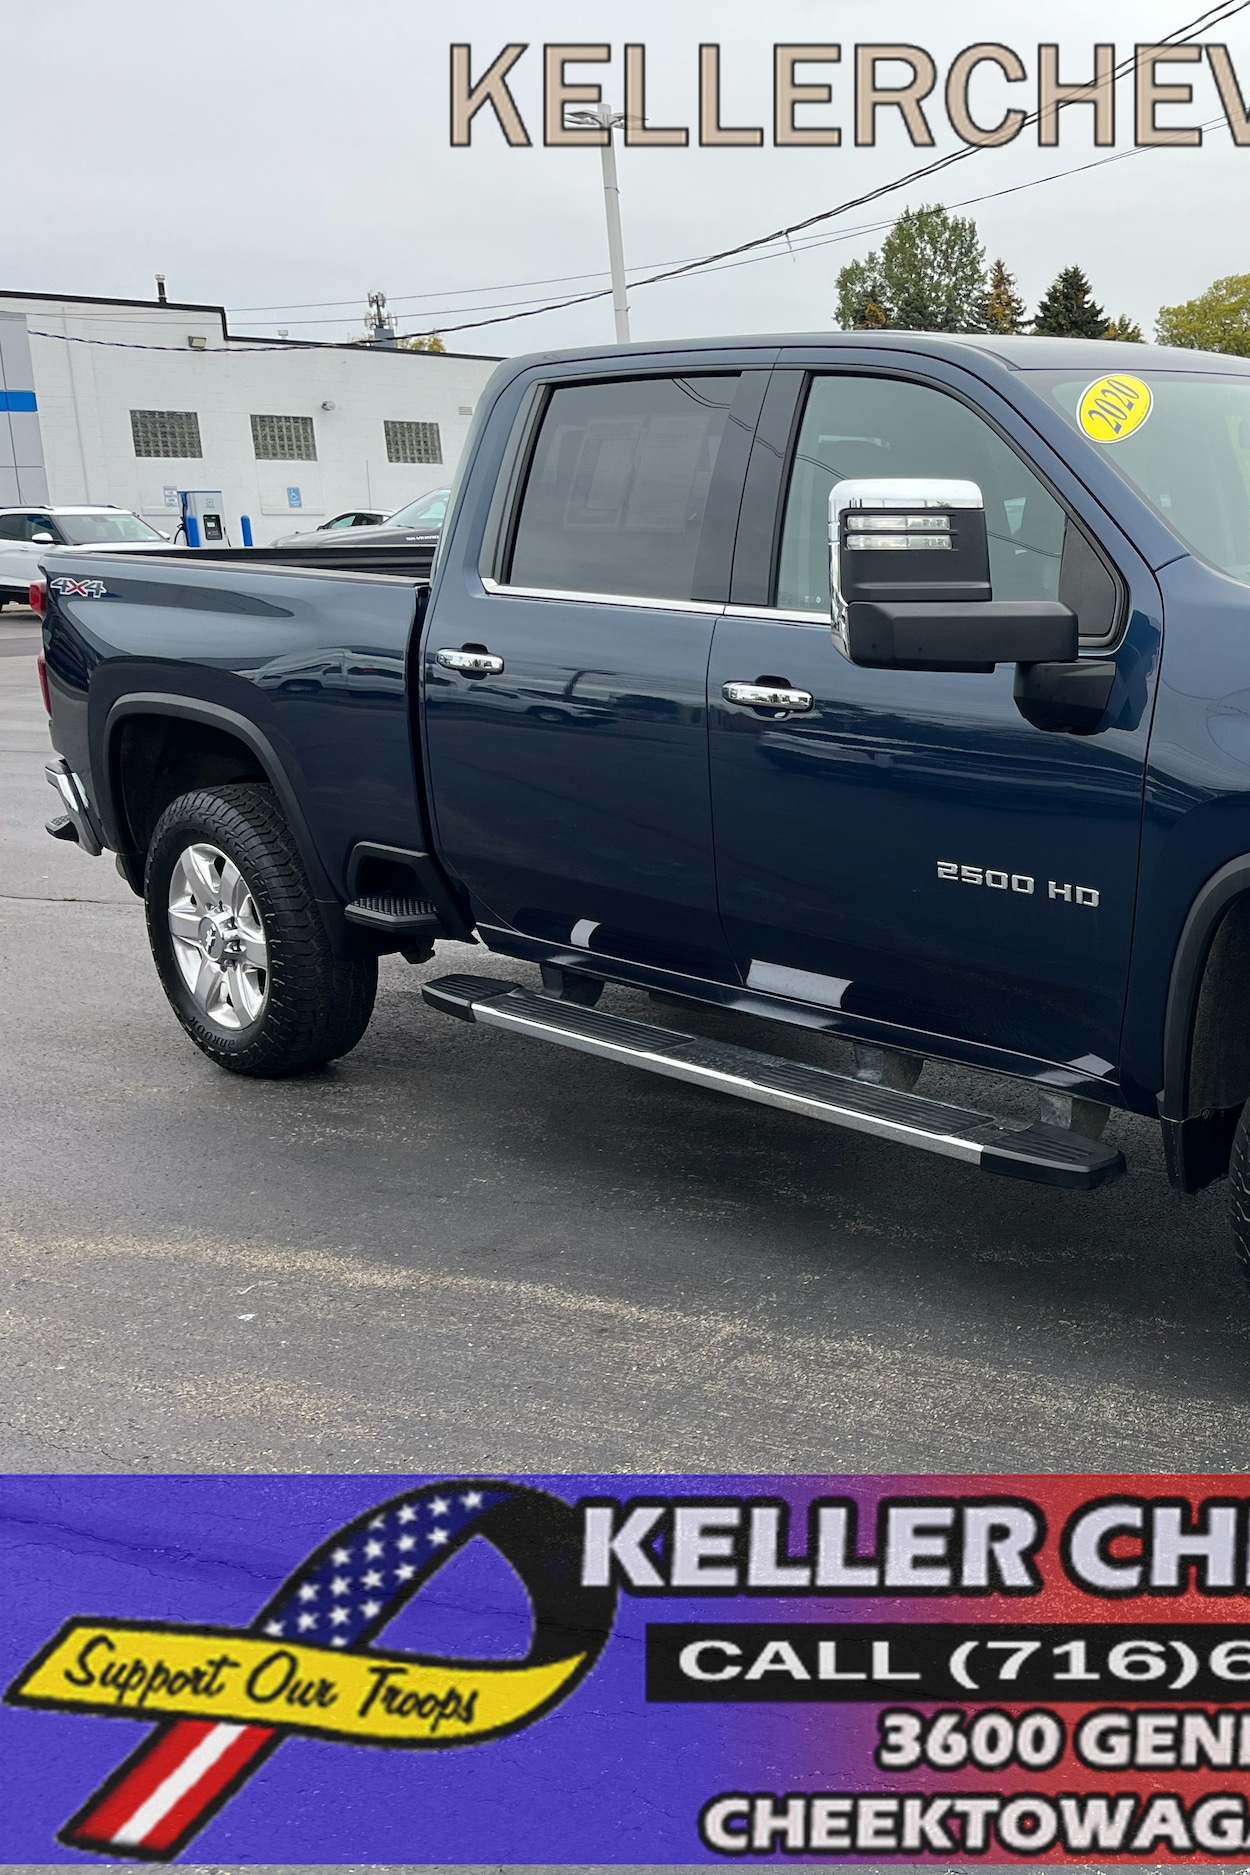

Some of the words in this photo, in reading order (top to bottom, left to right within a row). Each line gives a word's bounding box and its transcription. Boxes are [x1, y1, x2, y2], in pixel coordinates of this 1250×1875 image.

[1087, 379, 1140, 435] 2020
[936, 860, 1035, 895] 2500
[1047, 880, 1100, 908] HD
